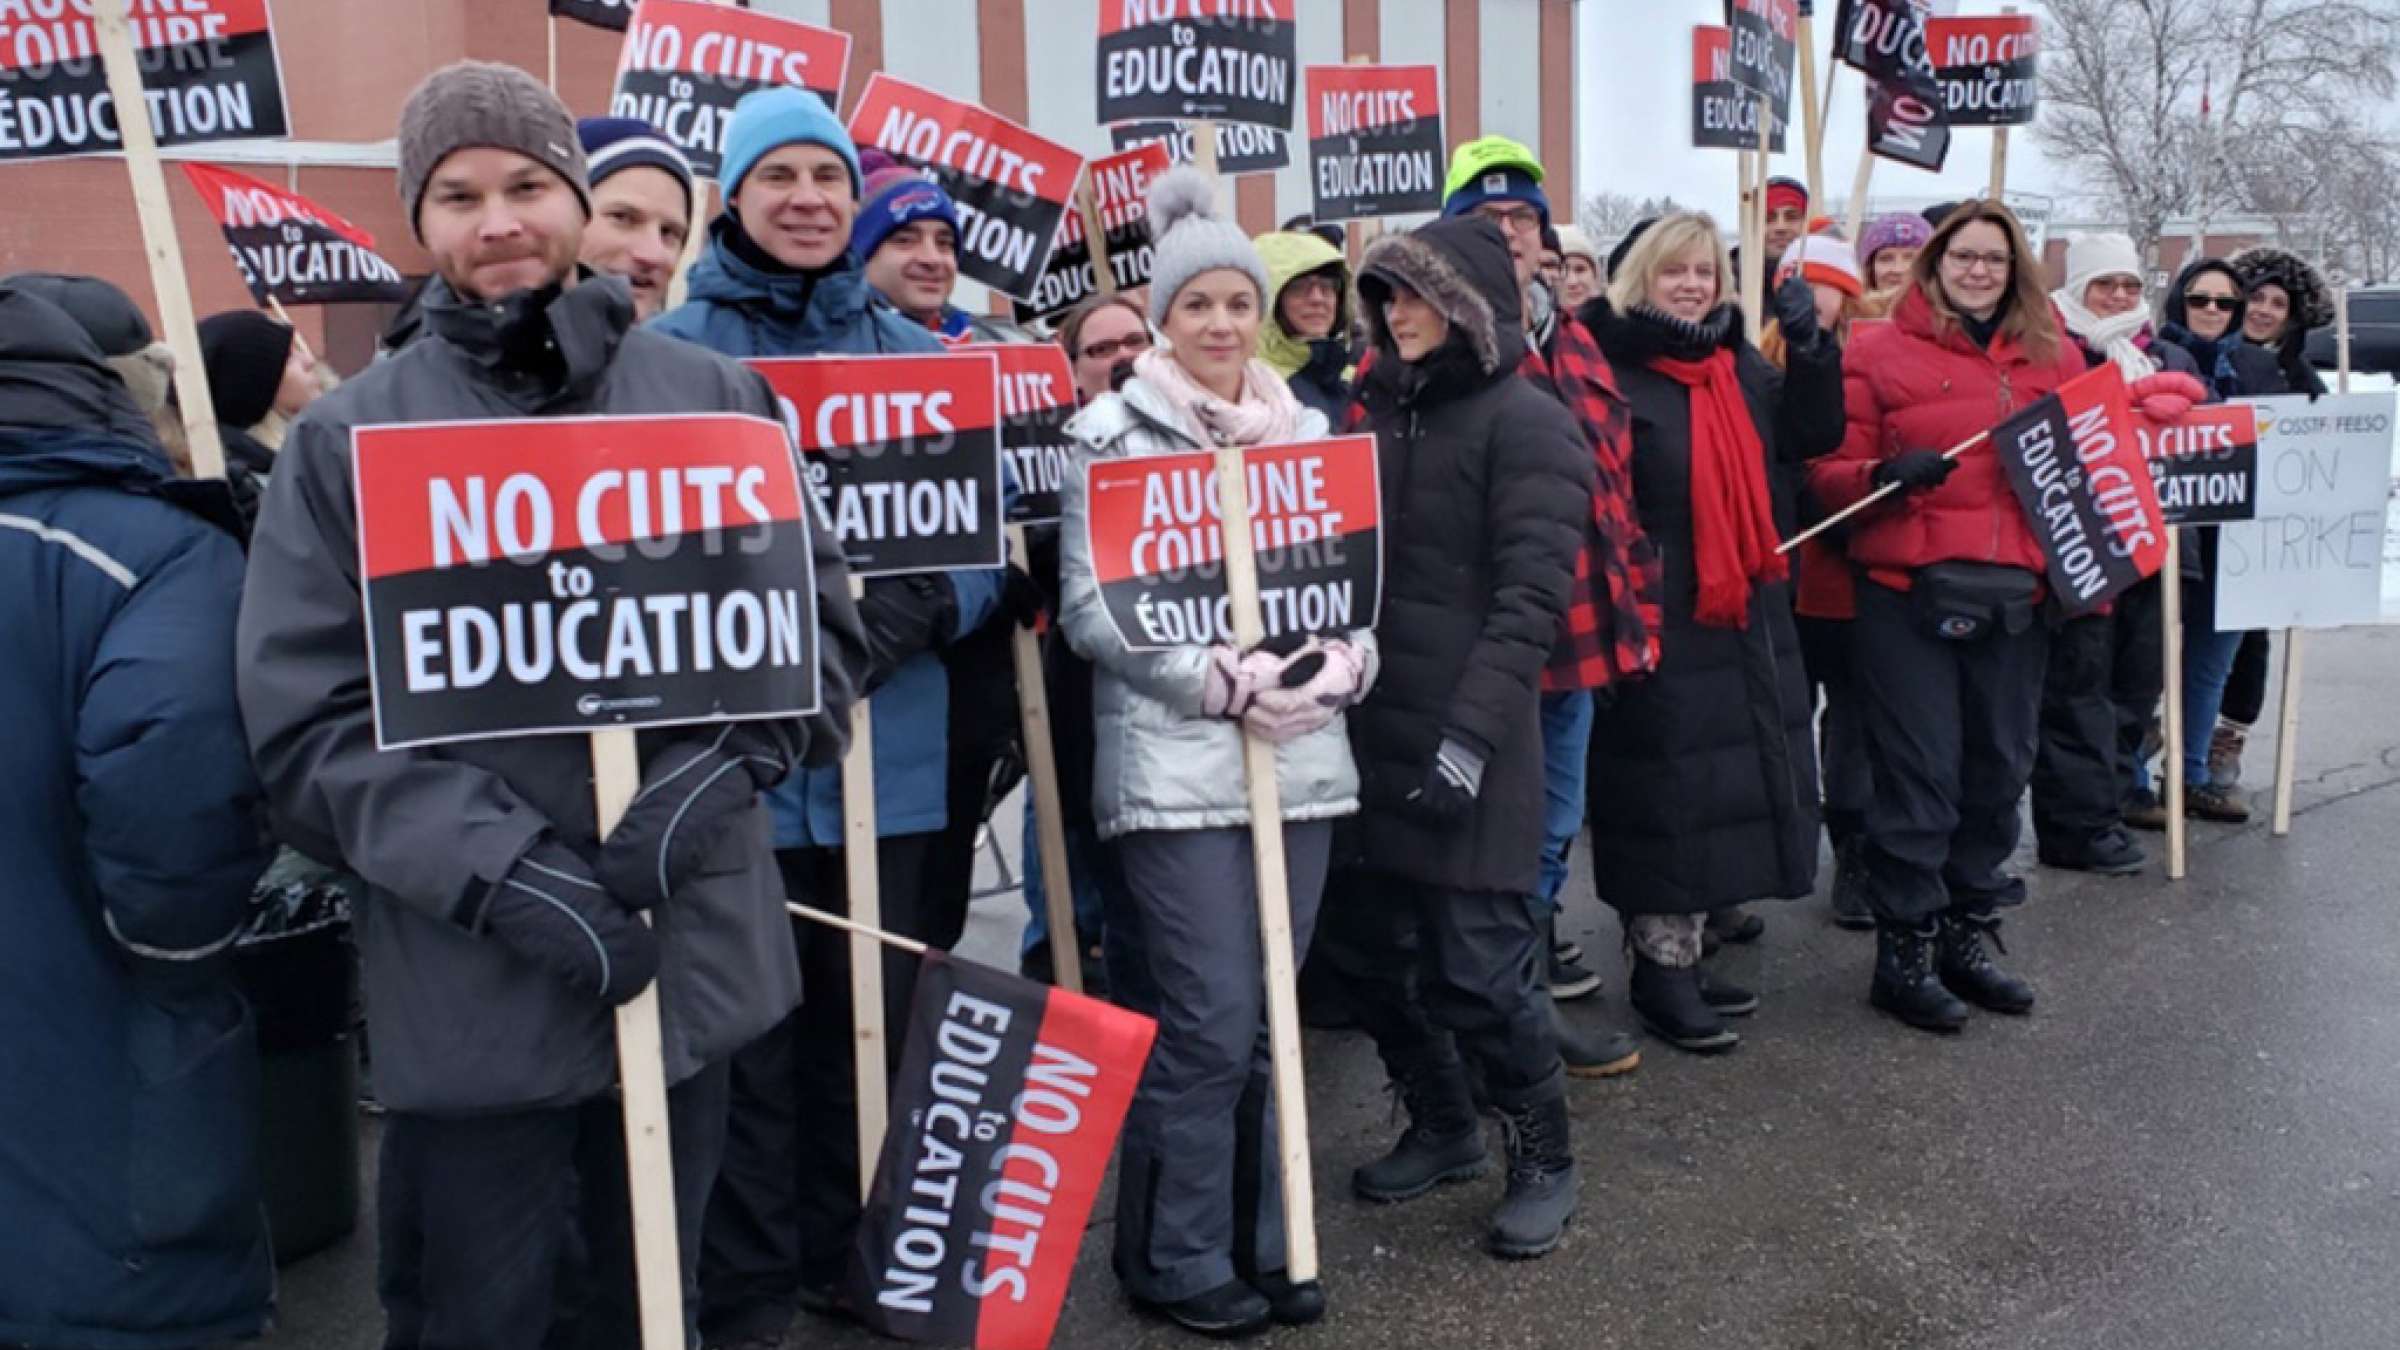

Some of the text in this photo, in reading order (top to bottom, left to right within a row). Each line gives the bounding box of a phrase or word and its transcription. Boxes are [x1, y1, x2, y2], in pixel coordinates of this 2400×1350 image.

[0, 14, 236, 82] OUURE
[630, 23, 808, 90] NO CUTS
[1172, 23, 1195, 46] to
[1945, 33, 1989, 67] NO
[669, 76, 693, 99] to
[1106, 46, 1287, 105] EDUCATION
[0, 80, 254, 148] ÉDUCTION
[1322, 88, 1418, 137] NO CUTS
[876, 105, 1045, 208] NO CUTS
[282, 223, 303, 242] to
[817, 391, 956, 459] CUTS
[2158, 424, 2234, 462] CUTS
[2065, 465, 2082, 489] to
[2068, 404, 2156, 557] NO CUTS
[2153, 471, 2246, 509] CATION
[2273, 448, 2341, 495] ON
[428, 466, 775, 568] NO CUTS
[2018, 418, 2109, 600] EDUCATION
[547, 561, 594, 598] to
[1131, 512, 1347, 585] COUURE
[401, 589, 804, 693] EDUCATION
[1135, 581, 1353, 645] ÉDUCTION
[877, 990, 1013, 1313] EDUCATION
[974, 1109, 1007, 1142] to
[960, 1042, 1099, 1303] NO CUTS
